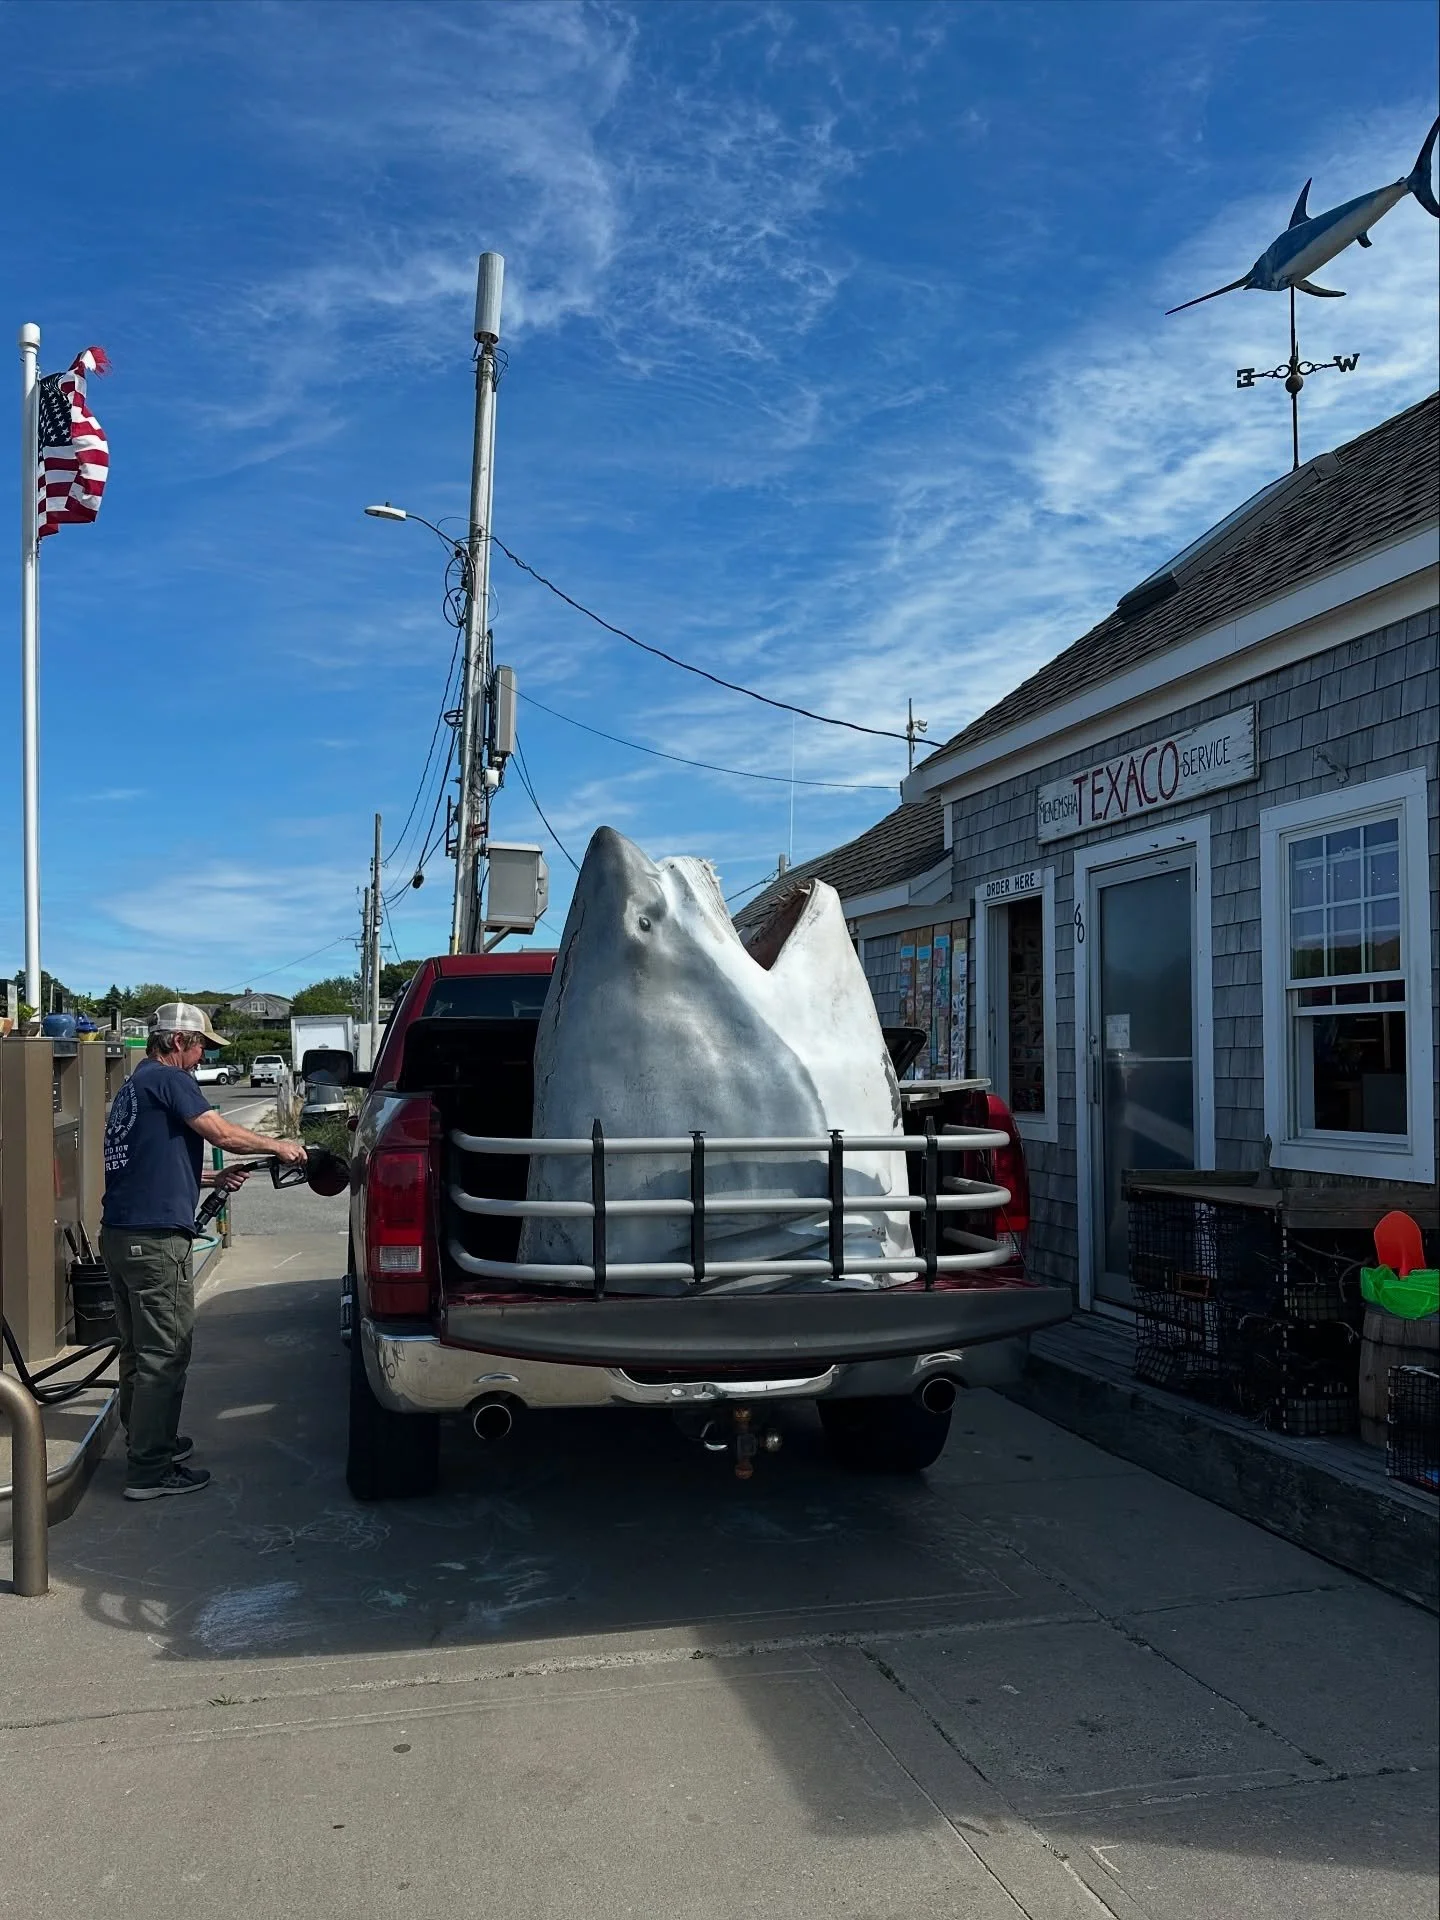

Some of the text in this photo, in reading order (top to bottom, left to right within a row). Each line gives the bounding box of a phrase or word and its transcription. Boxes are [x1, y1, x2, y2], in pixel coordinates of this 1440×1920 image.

[1333, 352, 1360, 373] W
[1039, 735, 1231, 826] MENEMSHA TEXACO SERVICE
[986, 872, 1035, 897] ORDER HERE
[1074, 903, 1085, 944] 60
